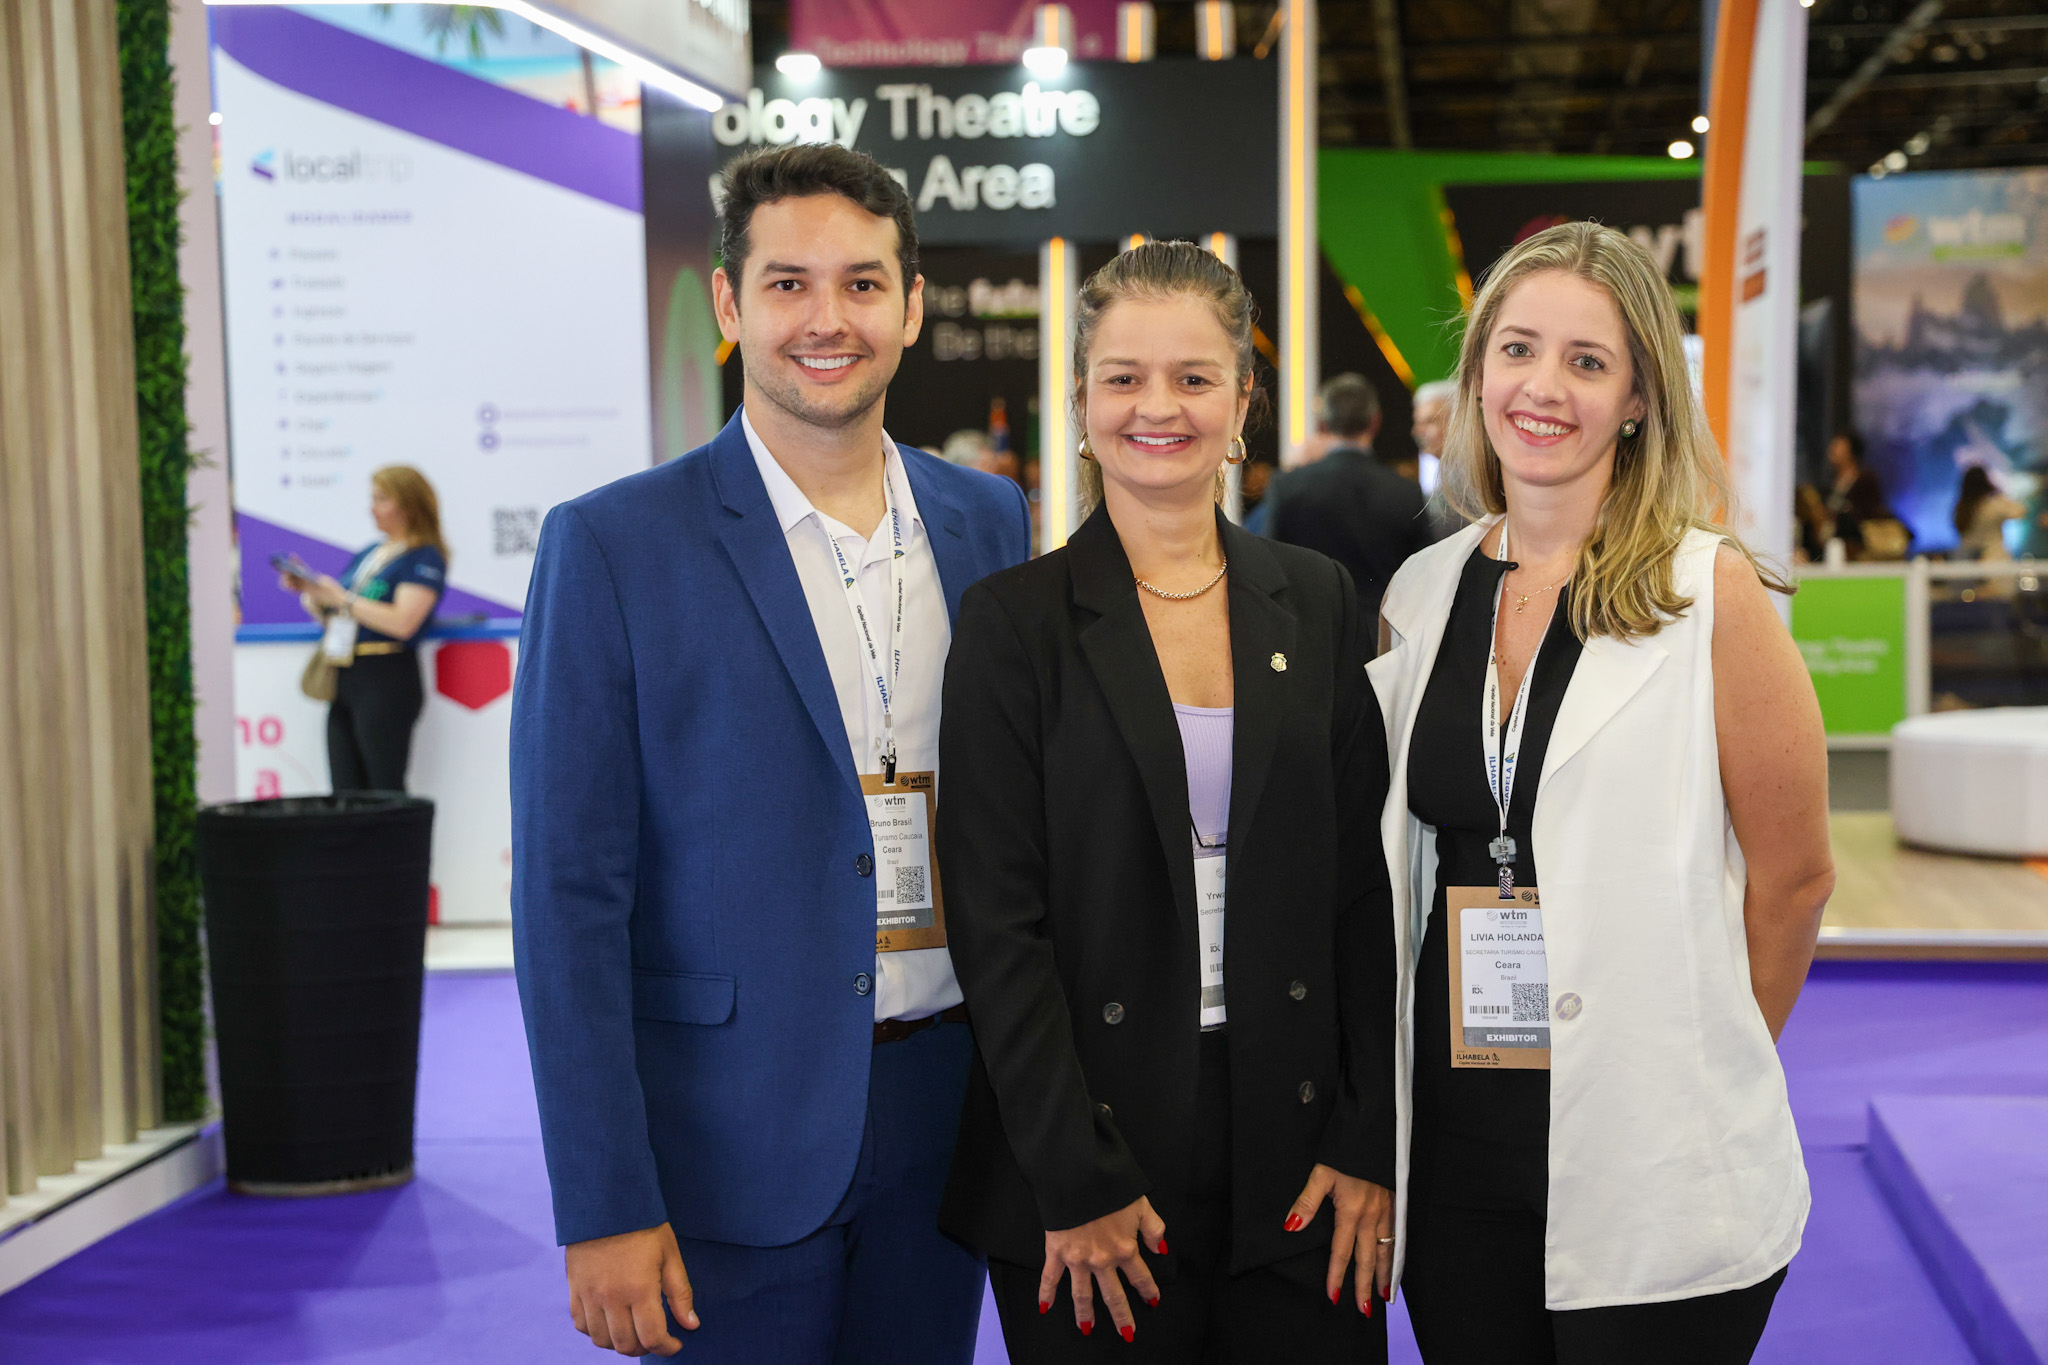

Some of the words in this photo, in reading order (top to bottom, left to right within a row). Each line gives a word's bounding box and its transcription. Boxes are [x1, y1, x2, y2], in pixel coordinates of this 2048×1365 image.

[876, 82, 1101, 140] Theatre
[917, 155, 1056, 211] Area
[891, 507, 902, 547] ILHABELA
[910, 774, 931, 784] wtm
[884, 795, 906, 806] wtm
[870, 819, 892, 828] Bruno
[892, 818, 913, 827] Brasil
[898, 832, 923, 841] Caucaia
[882, 845, 903, 854] Ceara
[1499, 909, 1528, 920] wtm
[876, 915, 916, 926] EXHIBITOR
[1470, 933, 1495, 941] LIVIA
[1497, 933, 1544, 942] HOLANDA
[1495, 960, 1521, 969] Ceara
[1486, 1033, 1538, 1042] EXHIBITOR
[1456, 1053, 1490, 1061] ILHABELA
